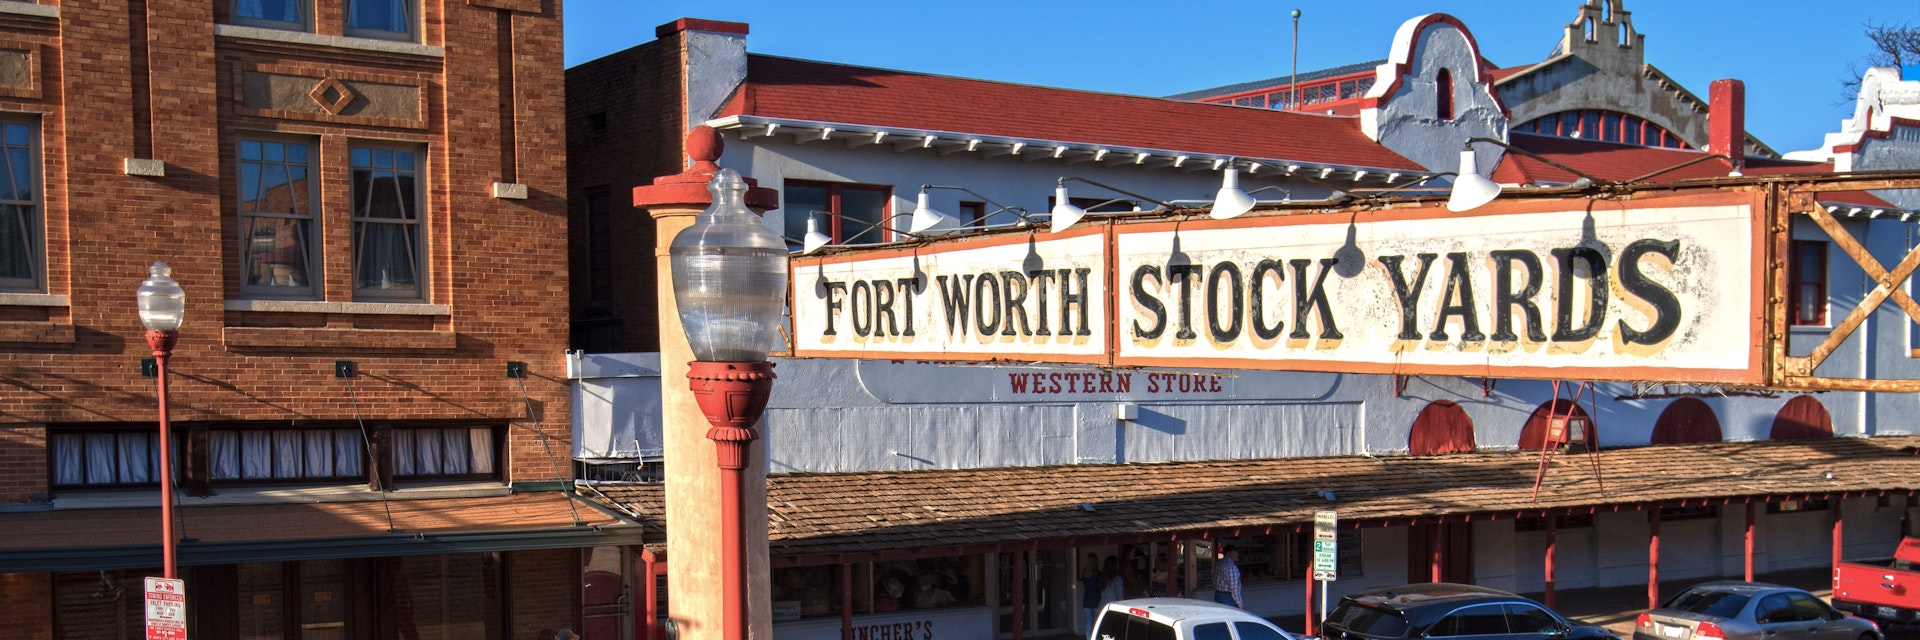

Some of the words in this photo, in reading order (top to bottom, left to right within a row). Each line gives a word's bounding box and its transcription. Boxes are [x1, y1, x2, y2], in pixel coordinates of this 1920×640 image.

[823, 277, 920, 338] FORT
[936, 268, 1092, 337] WORTH
[1130, 258, 1344, 341] STOCK
[1378, 239, 1682, 346] YARDS
[1009, 372, 1132, 394] WESTERN
[1147, 373, 1222, 393] STORE
[1316, 542, 1321, 551] 2
